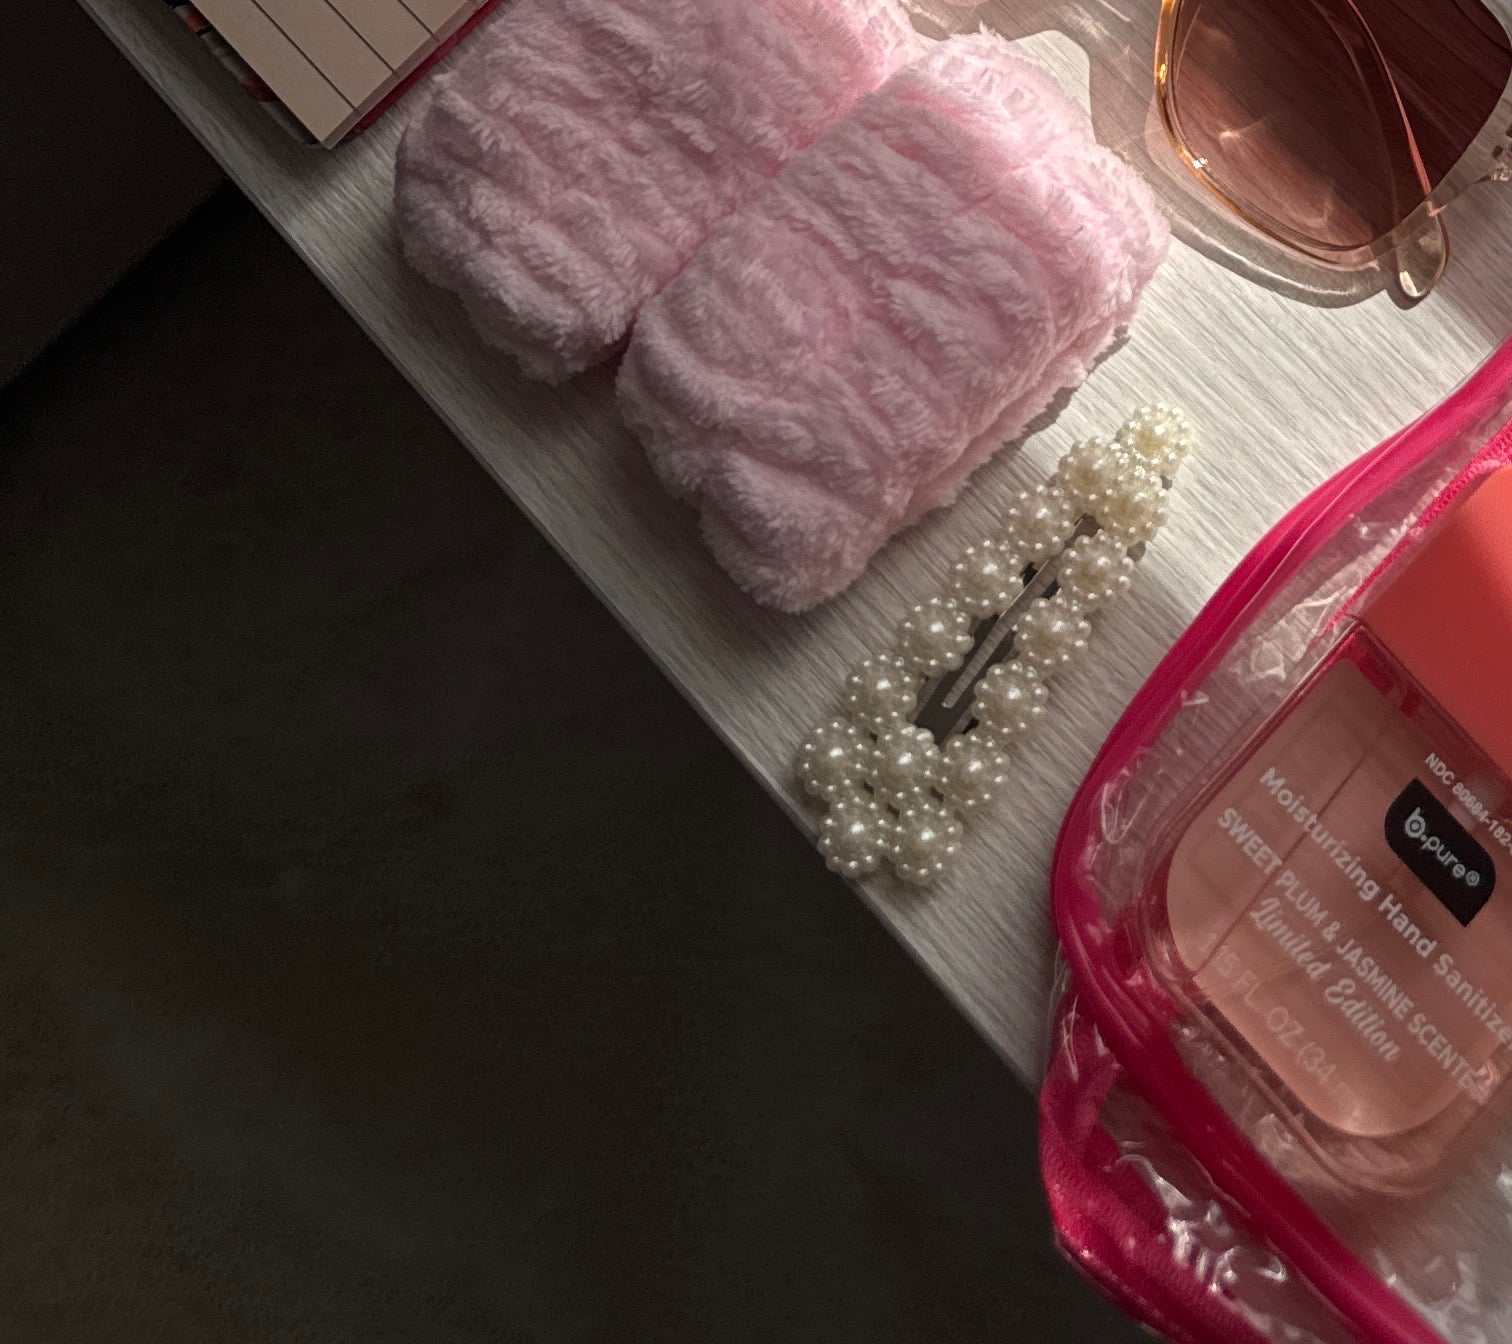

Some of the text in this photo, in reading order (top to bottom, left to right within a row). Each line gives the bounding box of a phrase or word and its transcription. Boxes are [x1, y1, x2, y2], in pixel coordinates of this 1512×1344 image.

[1424, 752, 1455, 785] NDC
[1218, 808, 1283, 874] SWEET
[1276, 870, 1329, 927] PLUM
[1323, 920, 1340, 942] &
[1336, 938, 1414, 1020] JASMINE
[1259, 766, 1380, 901] Moisturizing
[1378, 894, 1437, 958] Hand
[1250, 897, 1332, 980] Limited
[1324, 978, 1400, 1061] Edition
[1267, 1006, 1304, 1049] OZ
